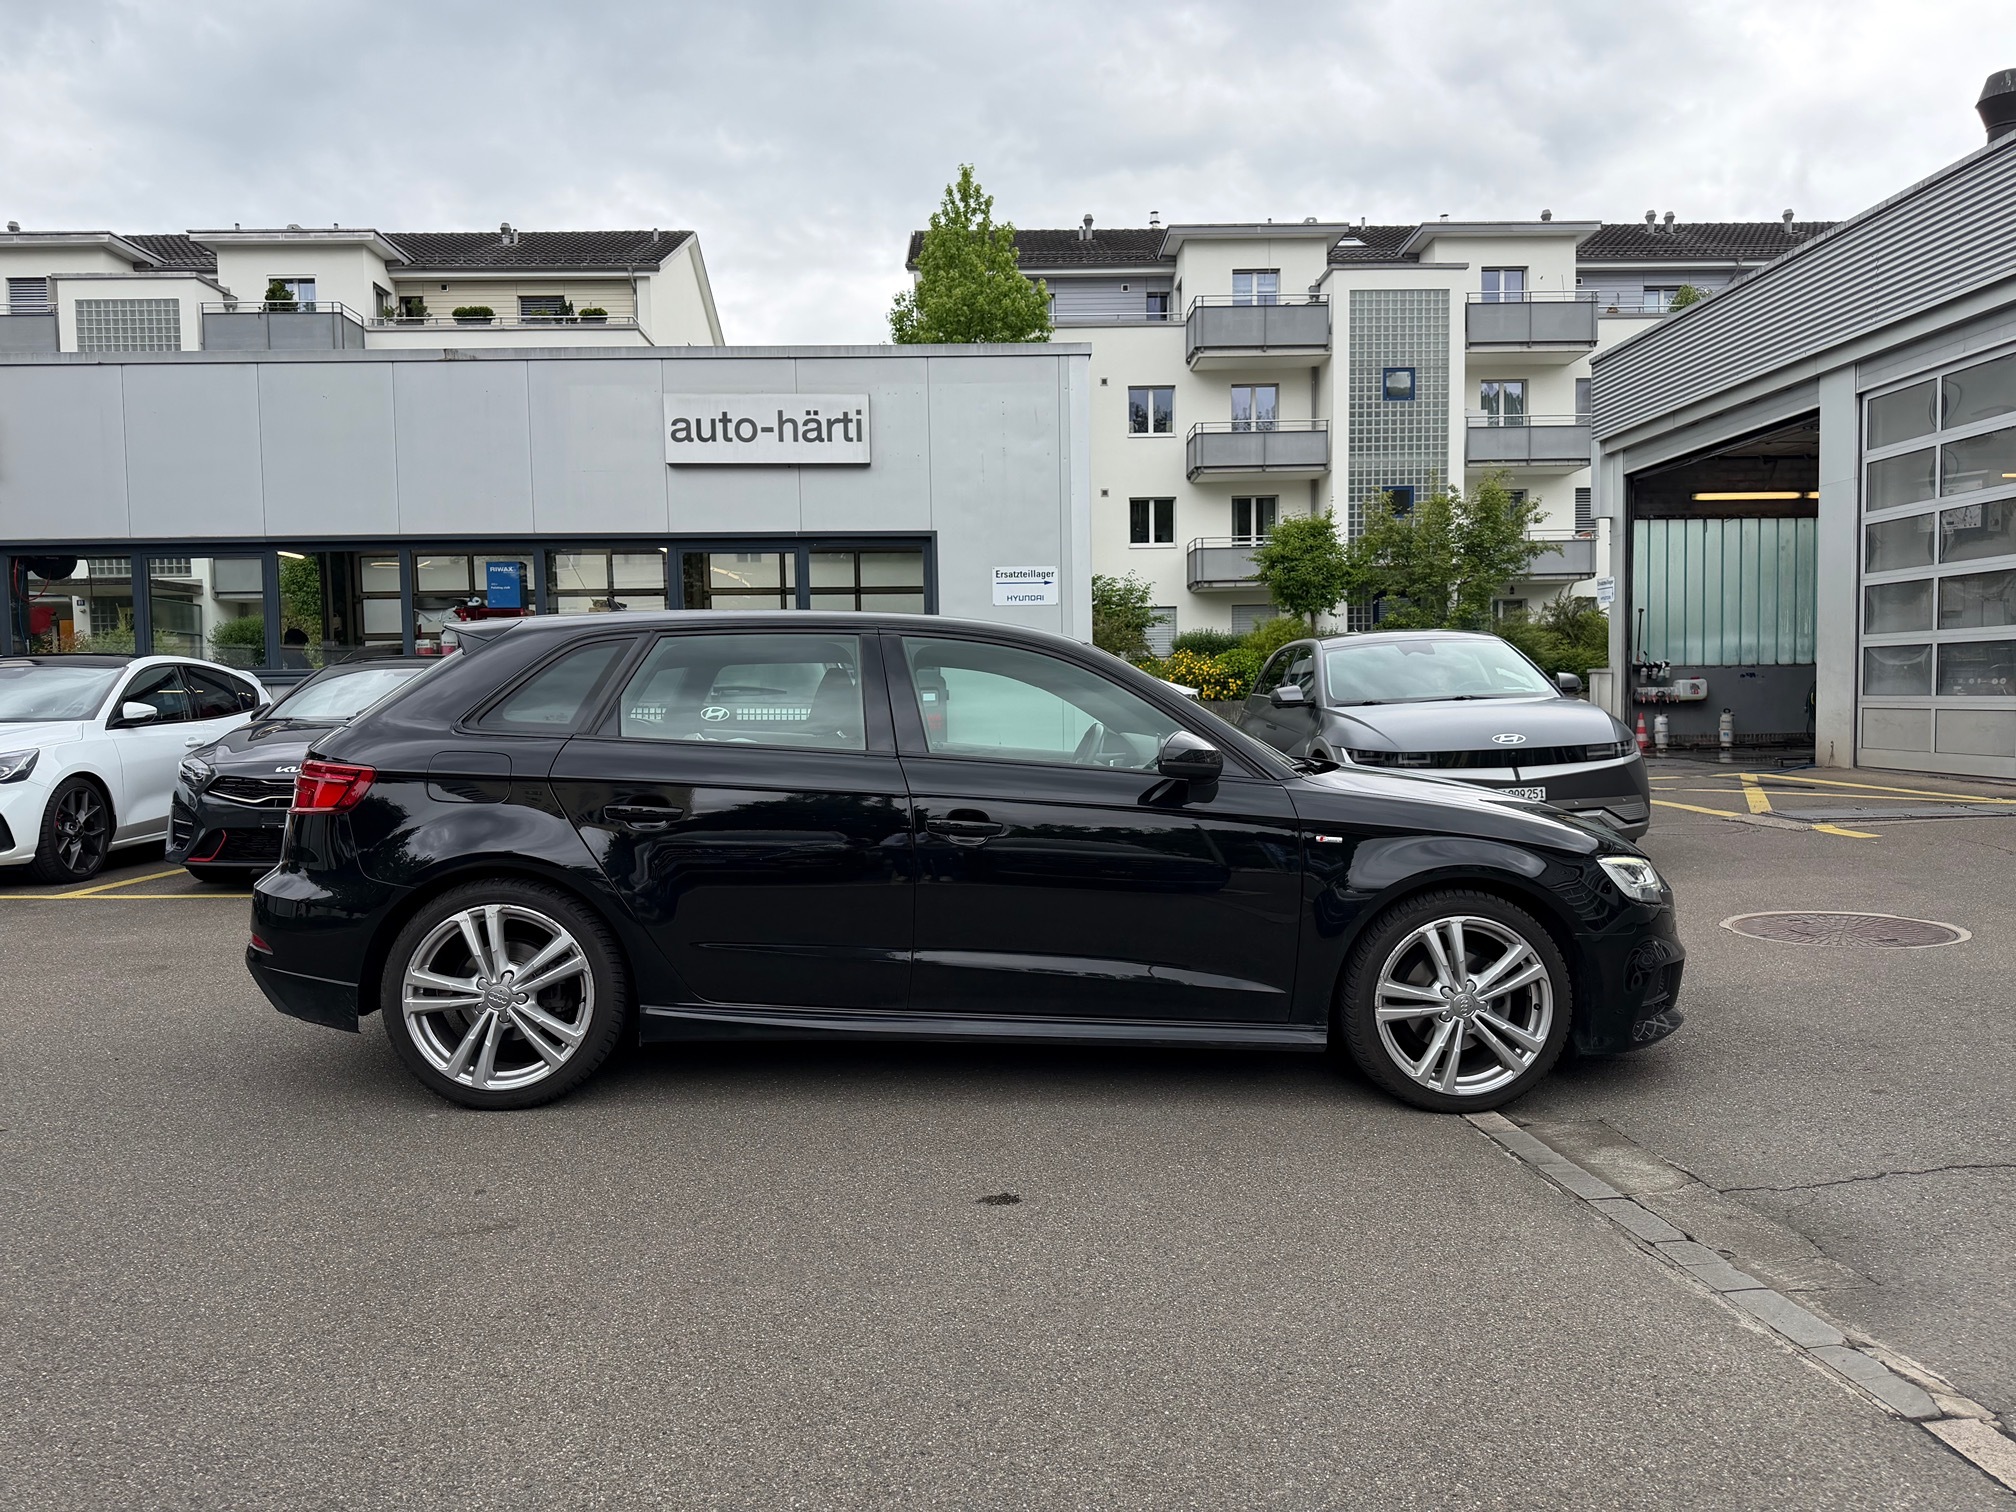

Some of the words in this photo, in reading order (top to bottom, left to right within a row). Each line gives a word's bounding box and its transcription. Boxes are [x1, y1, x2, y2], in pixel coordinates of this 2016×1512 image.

[670, 409, 863, 443] auto-härti
[995, 569, 1055, 580] Ersatzteillager
[1006, 594, 1045, 602] HYUNDAI
